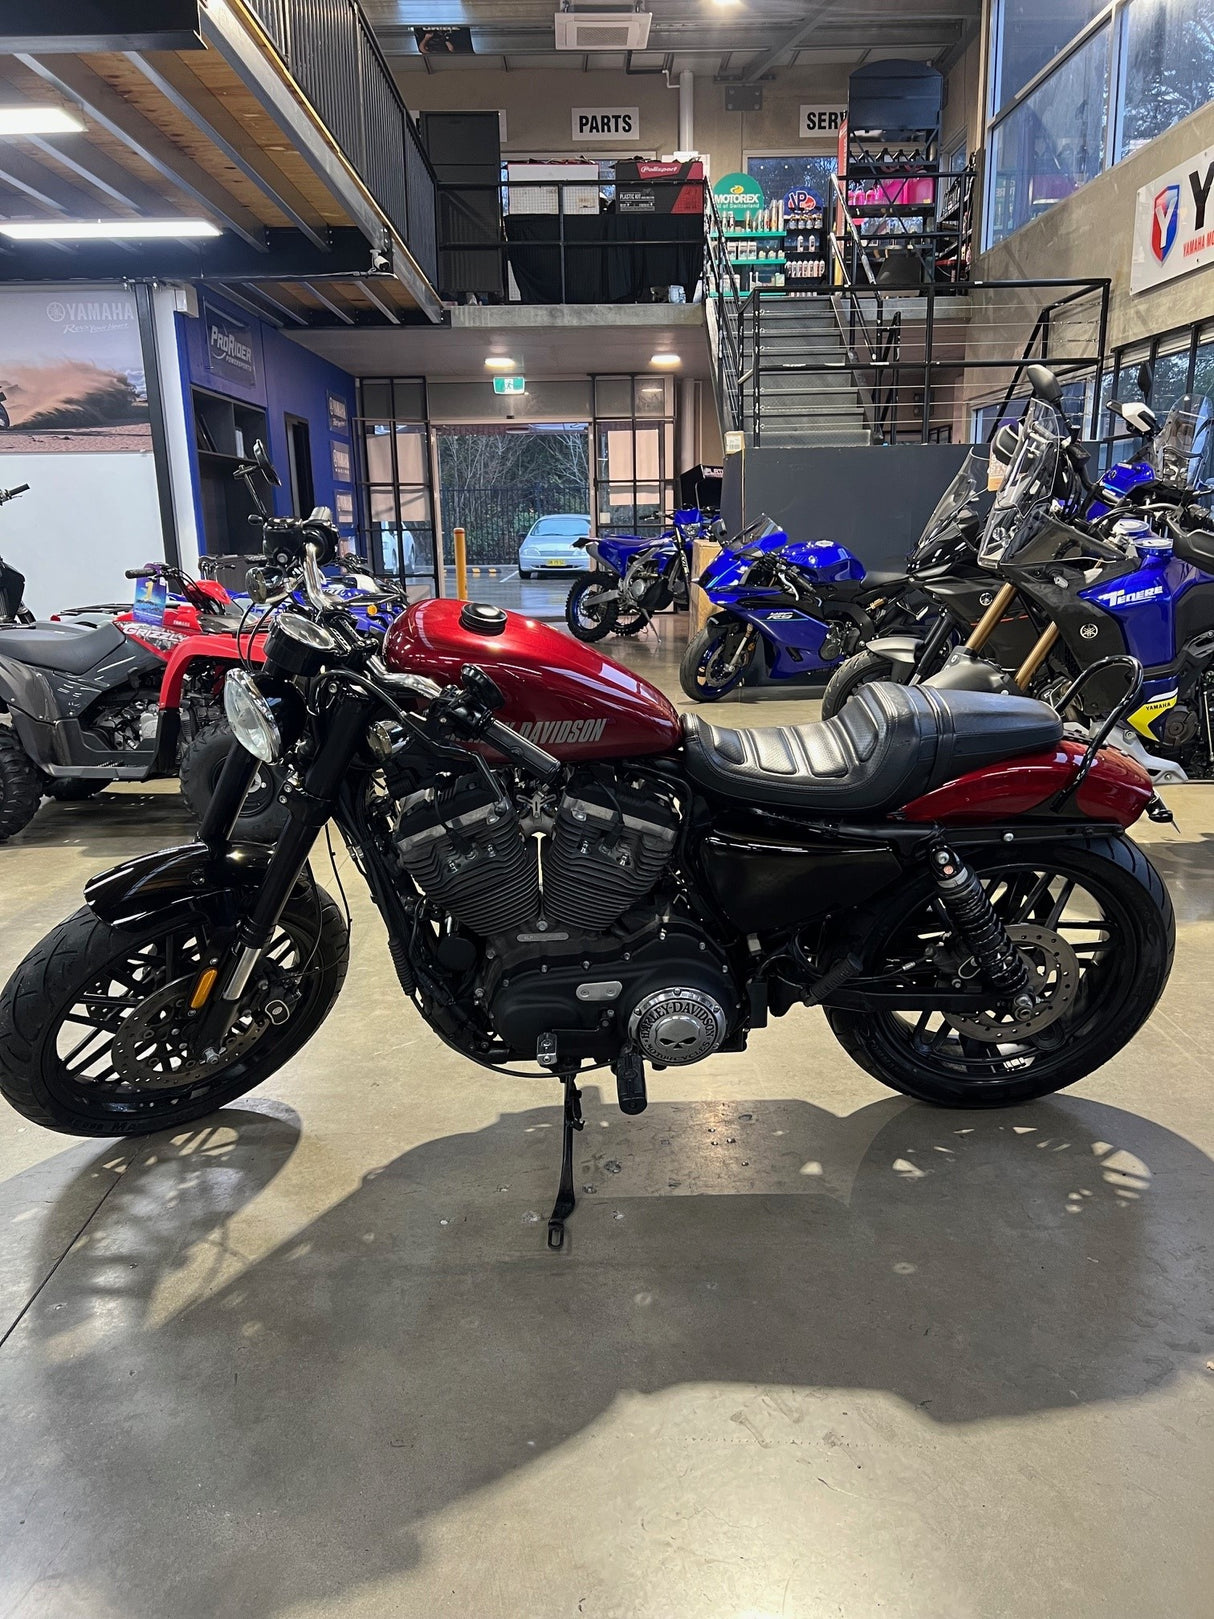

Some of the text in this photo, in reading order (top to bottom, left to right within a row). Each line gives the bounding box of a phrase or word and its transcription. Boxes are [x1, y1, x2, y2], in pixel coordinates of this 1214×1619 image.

[579, 114, 632, 133] PARTS
[714, 194, 759, 203] MOTOREX
[1183, 233, 1205, 258] YAMAHA
[66, 302, 134, 321] YAMAHA
[1145, 702, 1171, 710] YAMAHA
[641, 1001, 715, 1039] HARLEY-DAVIDSON
[644, 1041, 710, 1061] MOTORCYCLES
